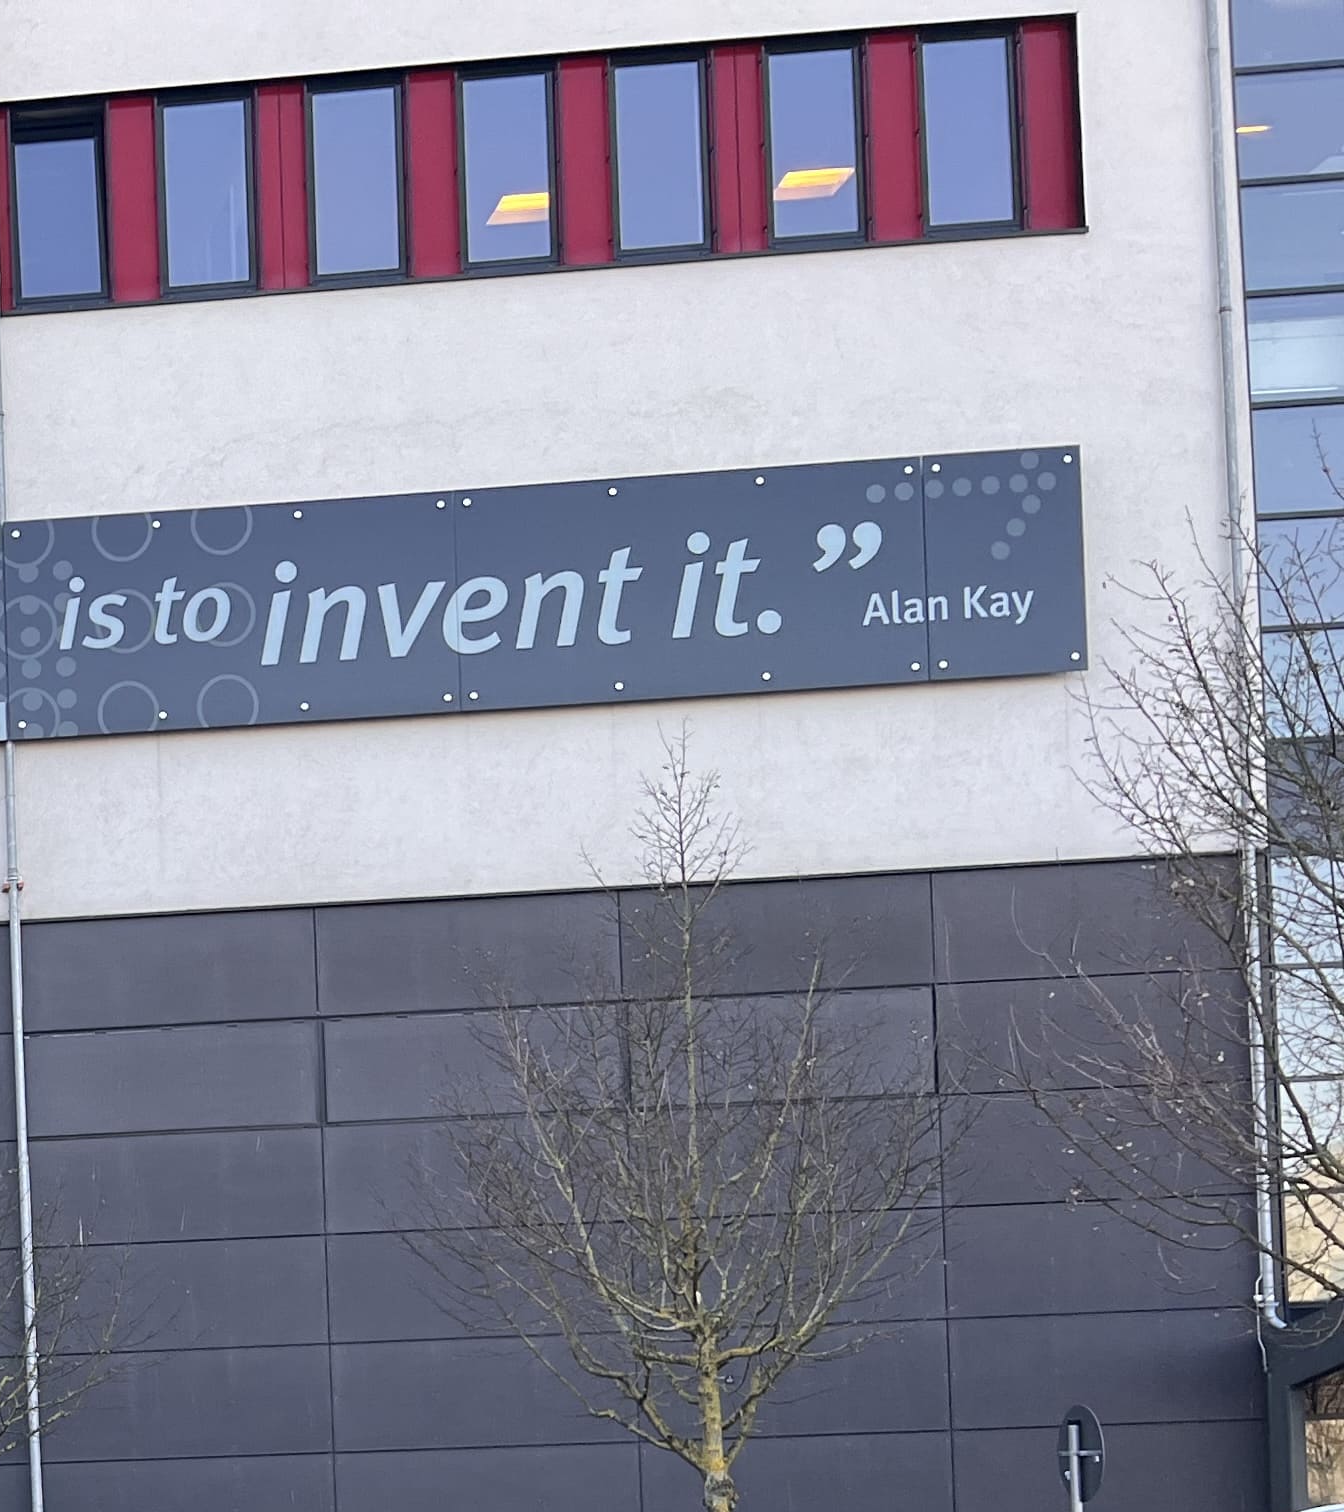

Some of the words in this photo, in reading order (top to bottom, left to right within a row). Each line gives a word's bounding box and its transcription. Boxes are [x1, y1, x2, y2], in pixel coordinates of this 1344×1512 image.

[59, 576, 127, 651] is
[153, 576, 231, 645] to
[260, 546, 643, 666] invent
[862, 589, 949, 627] Alan
[962, 584, 1035, 626] Kay
